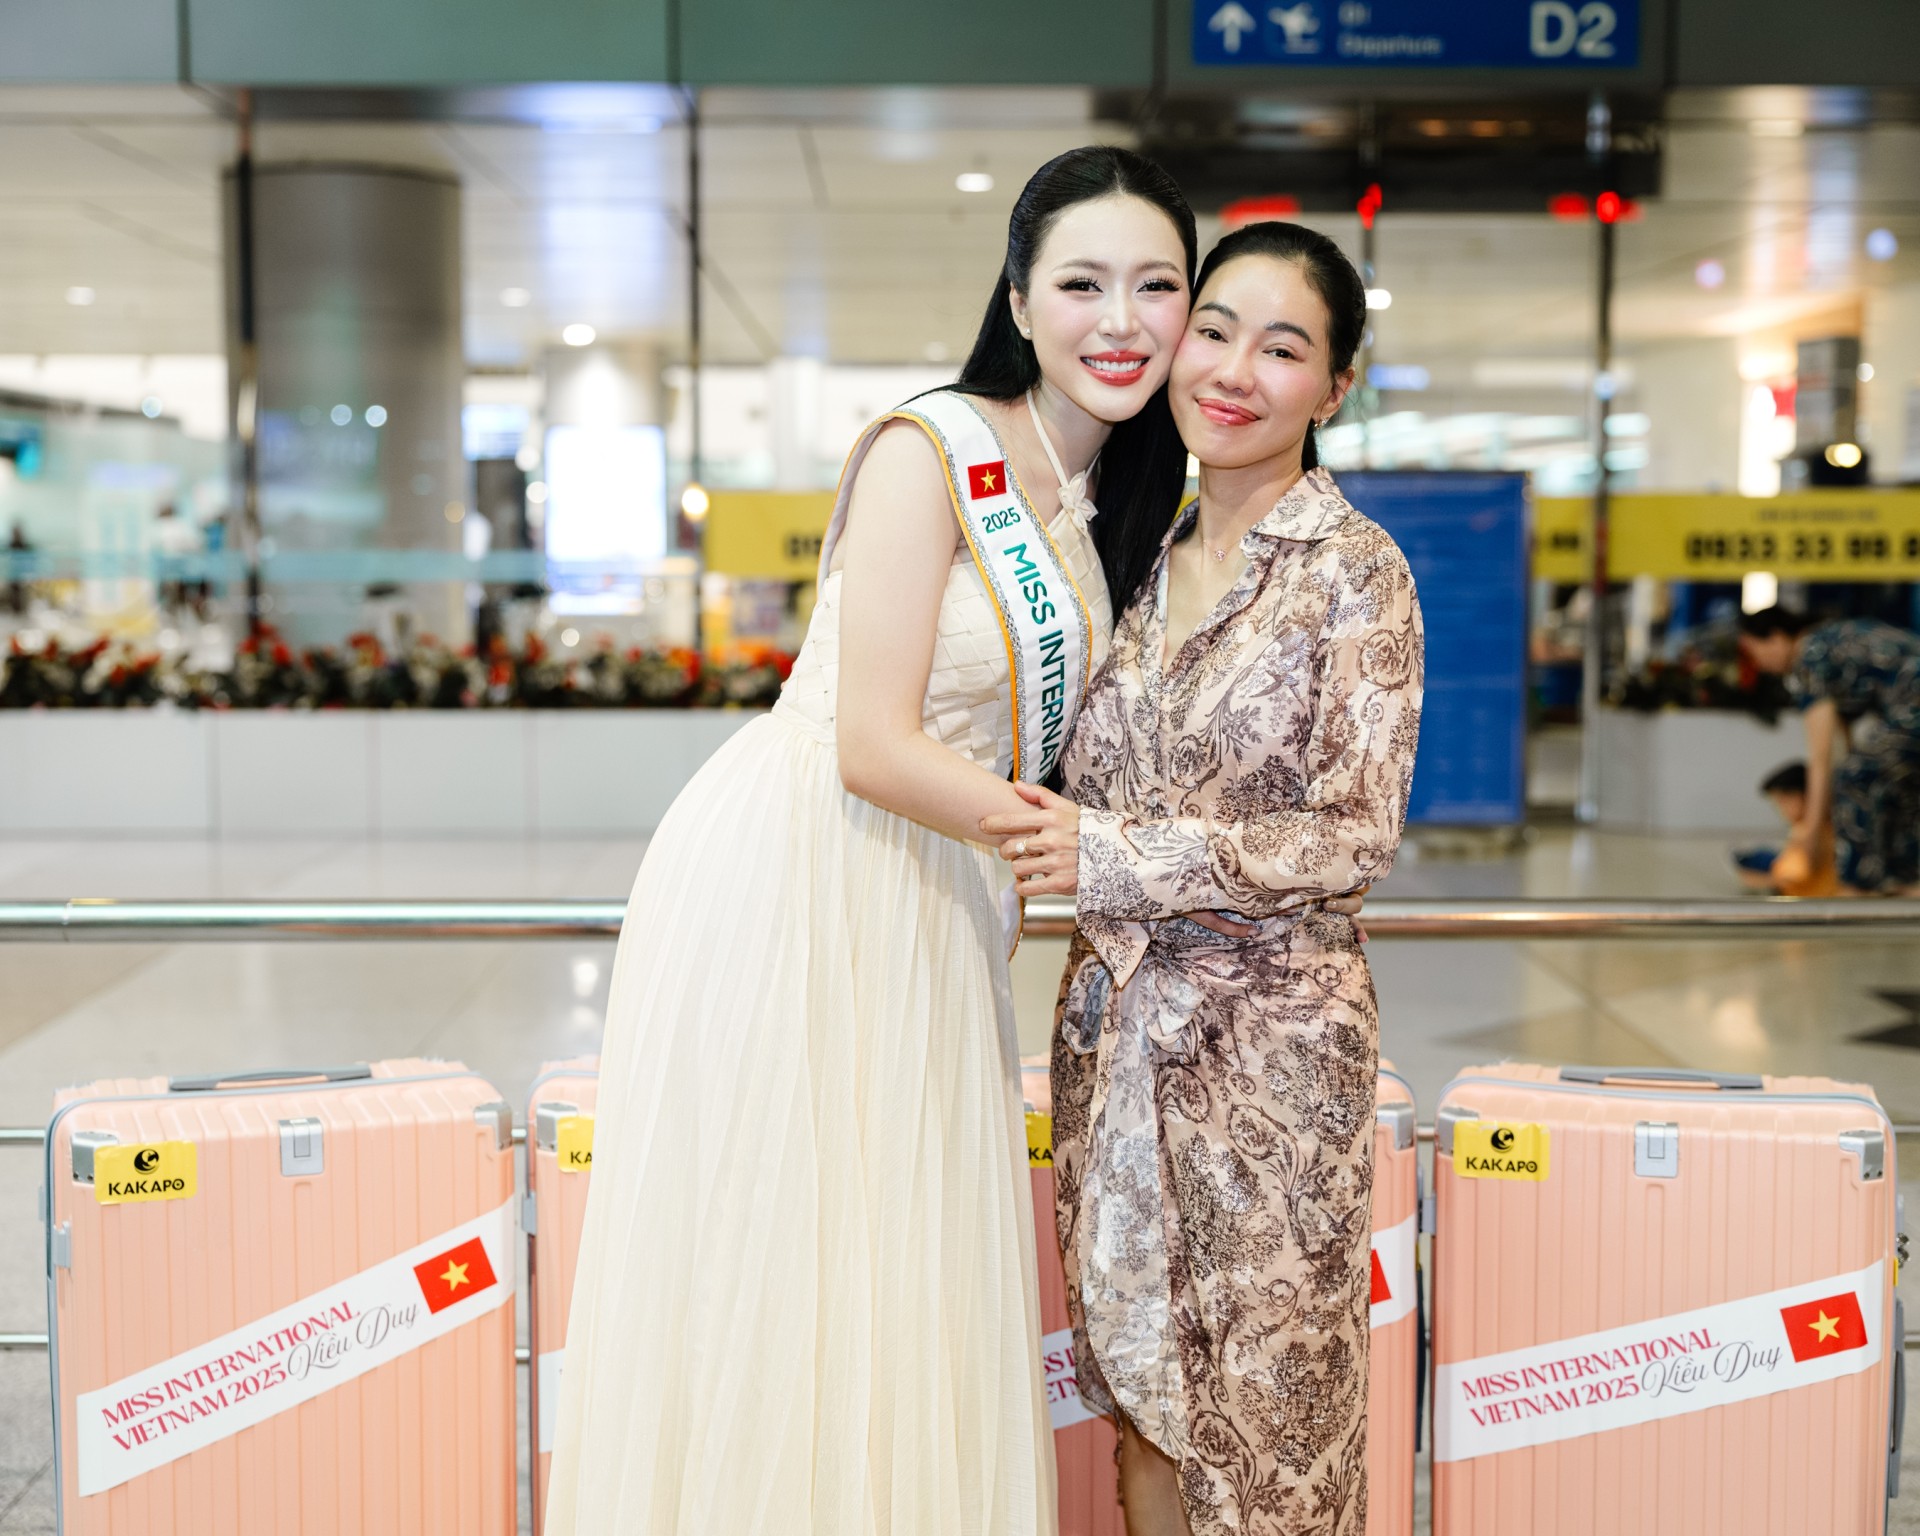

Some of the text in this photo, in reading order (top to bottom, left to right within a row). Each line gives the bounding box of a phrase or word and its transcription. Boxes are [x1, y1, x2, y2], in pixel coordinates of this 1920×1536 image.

[1529, 1, 1617, 57] D2
[982, 507, 1021, 534] 2025
[1003, 542, 1056, 625] MISS
[108, 1178, 185, 1196] KAKAPO
[1466, 1157, 1538, 1173] KAKAPO
[101, 1301, 361, 1428] MISS INTERNATIONAL
[112, 1389, 230, 1451] VIETNAM
[227, 1361, 287, 1402] 2025
[356, 1303, 420, 1349] Duy
[1461, 1328, 1721, 1401] MISS INTERNATIONAL
[1469, 1388, 1581, 1427] VIETNAM
[1581, 1374, 1640, 1406] 2025
[1713, 1340, 1782, 1383] Duy
